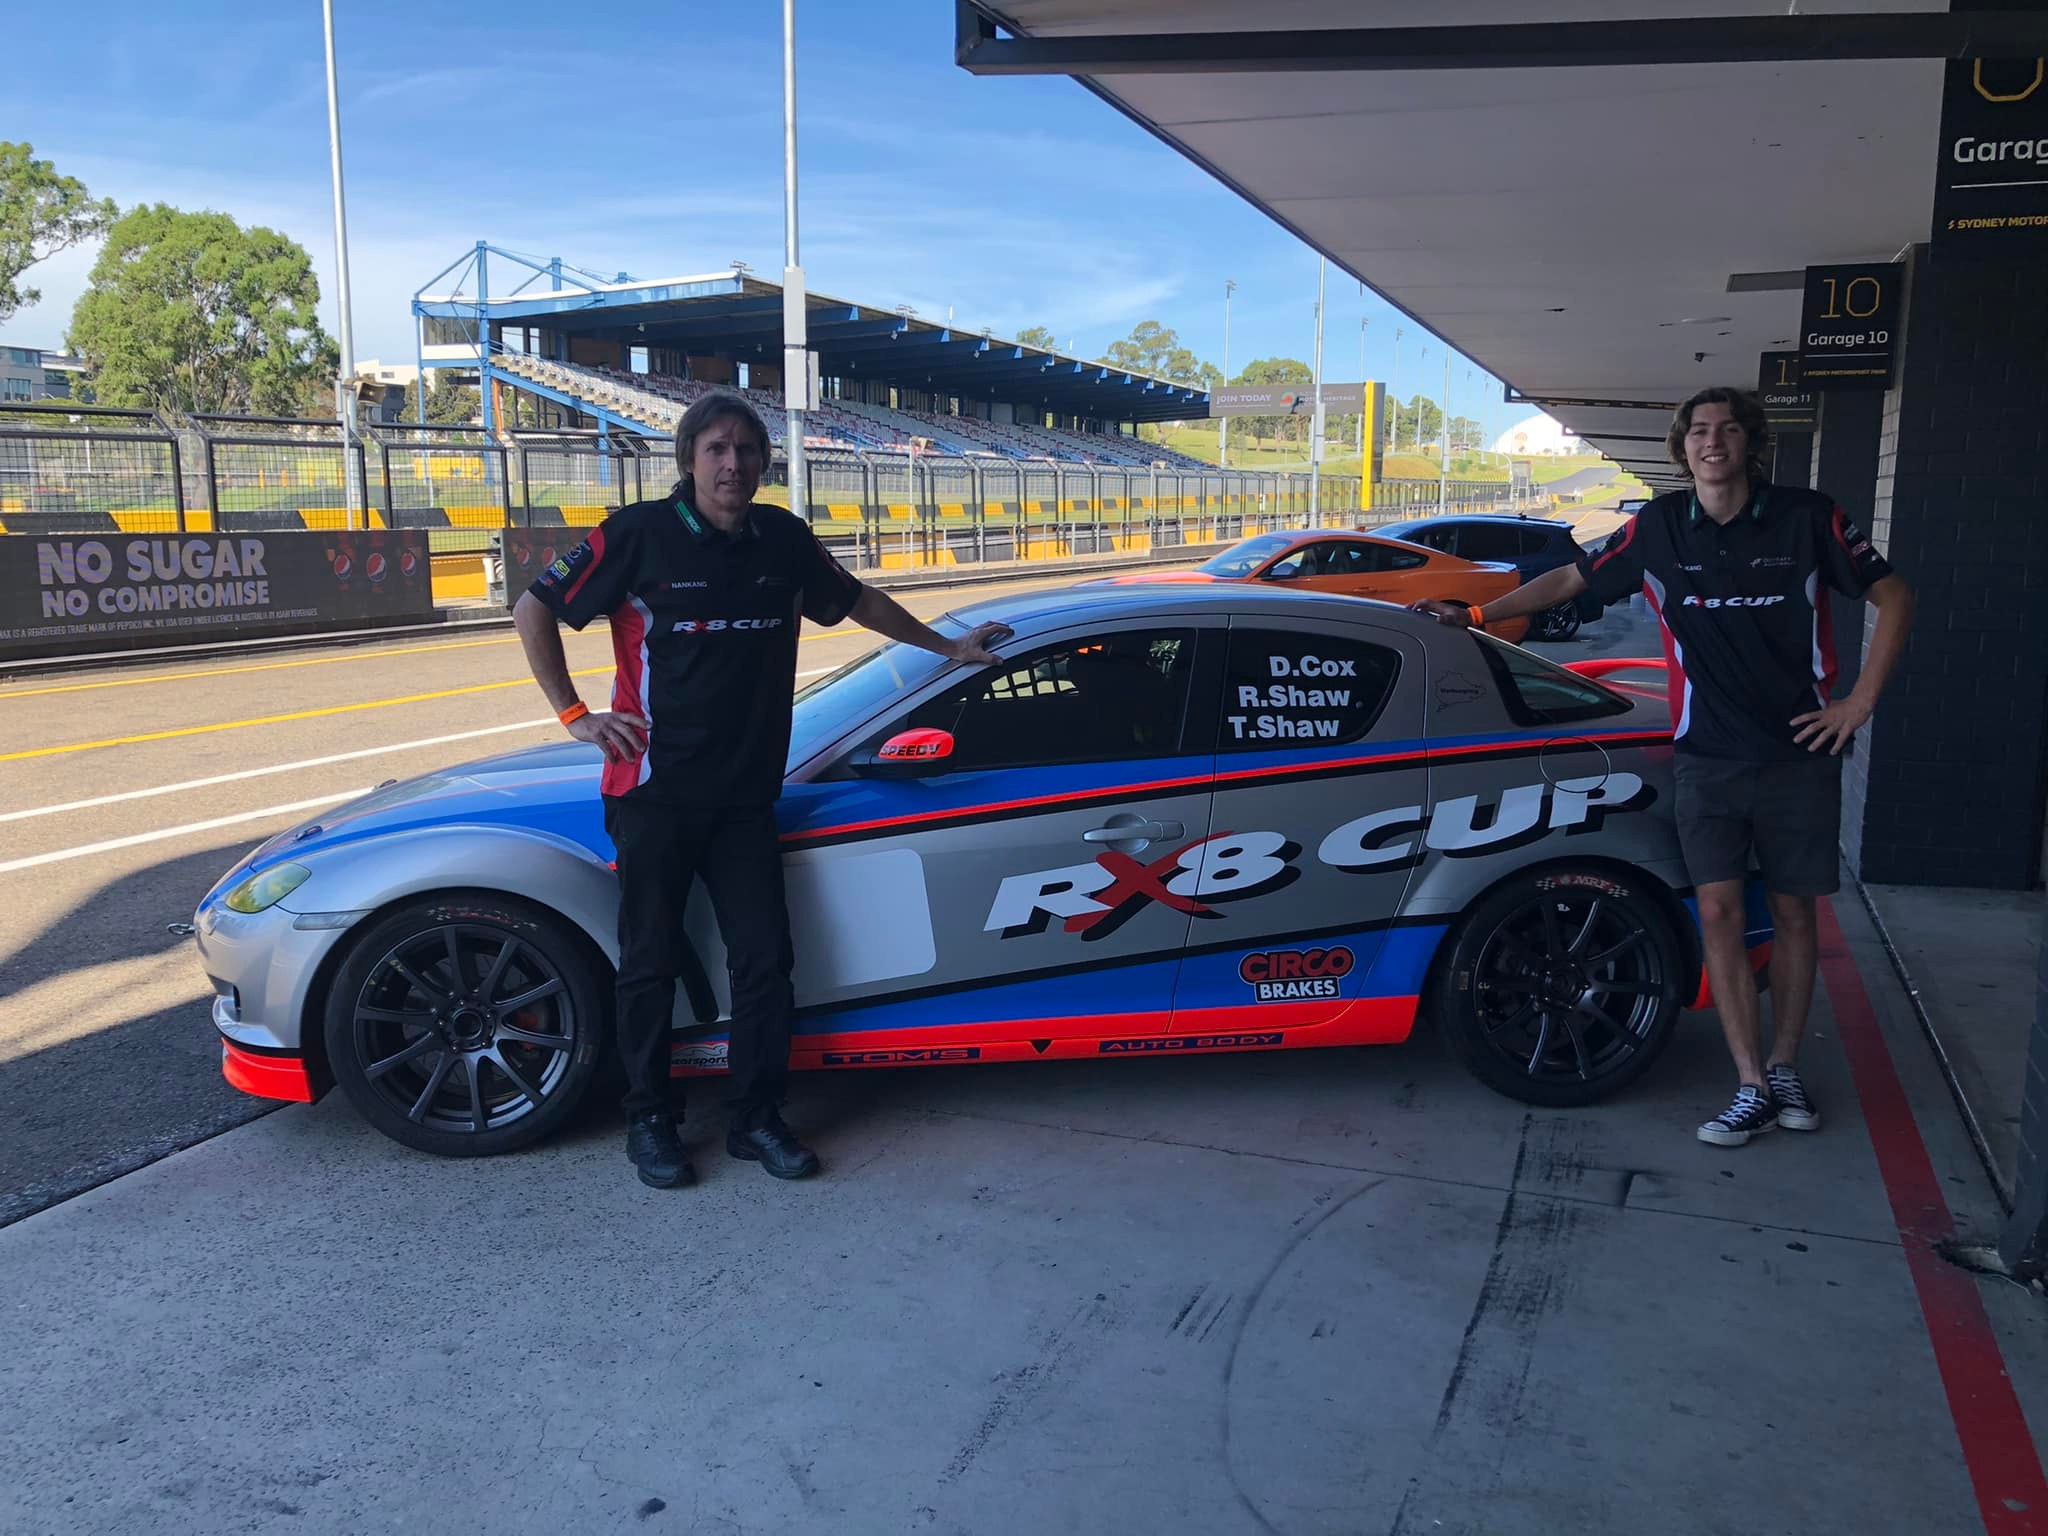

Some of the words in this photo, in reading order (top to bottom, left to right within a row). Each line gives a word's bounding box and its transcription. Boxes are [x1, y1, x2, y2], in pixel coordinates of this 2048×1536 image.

[1953, 136, 2048, 166] Garag
[1957, 217, 2006, 230] SYDNEY
[1820, 277, 1881, 318] 10
[1807, 332, 1865, 348] Garage
[1868, 330, 1889, 344] 10
[1775, 359, 1799, 386] 1
[1239, 393, 1272, 402] TODAY
[1764, 393, 1798, 405] Garage
[1800, 393, 1811, 403] 11
[37, 541, 113, 585] NO
[126, 539, 267, 582] SUGAR
[672, 581, 708, 589] NANKANG
[42, 589, 89, 618] NO
[98, 581, 270, 614] COMPROMISE
[1724, 595, 1785, 606] CUP
[672, 619, 727, 634] RX8
[731, 618, 783, 630] CUP
[1269, 655, 1357, 677] D.Cox
[1238, 685, 1350, 708] R.Shaw
[1227, 715, 1339, 738] T.Shaw
[880, 743, 942, 756] SPEEDY
[984, 829, 1294, 936] RX8
[1318, 771, 1650, 870] CUP
[1241, 947, 1354, 982] CIRCO
[1260, 980, 1336, 999] BRAKES
[1106, 1039, 1185, 1050] AUTO
[1196, 1035, 1276, 1047] BODY
[831, 1049, 969, 1064] TOM'S
